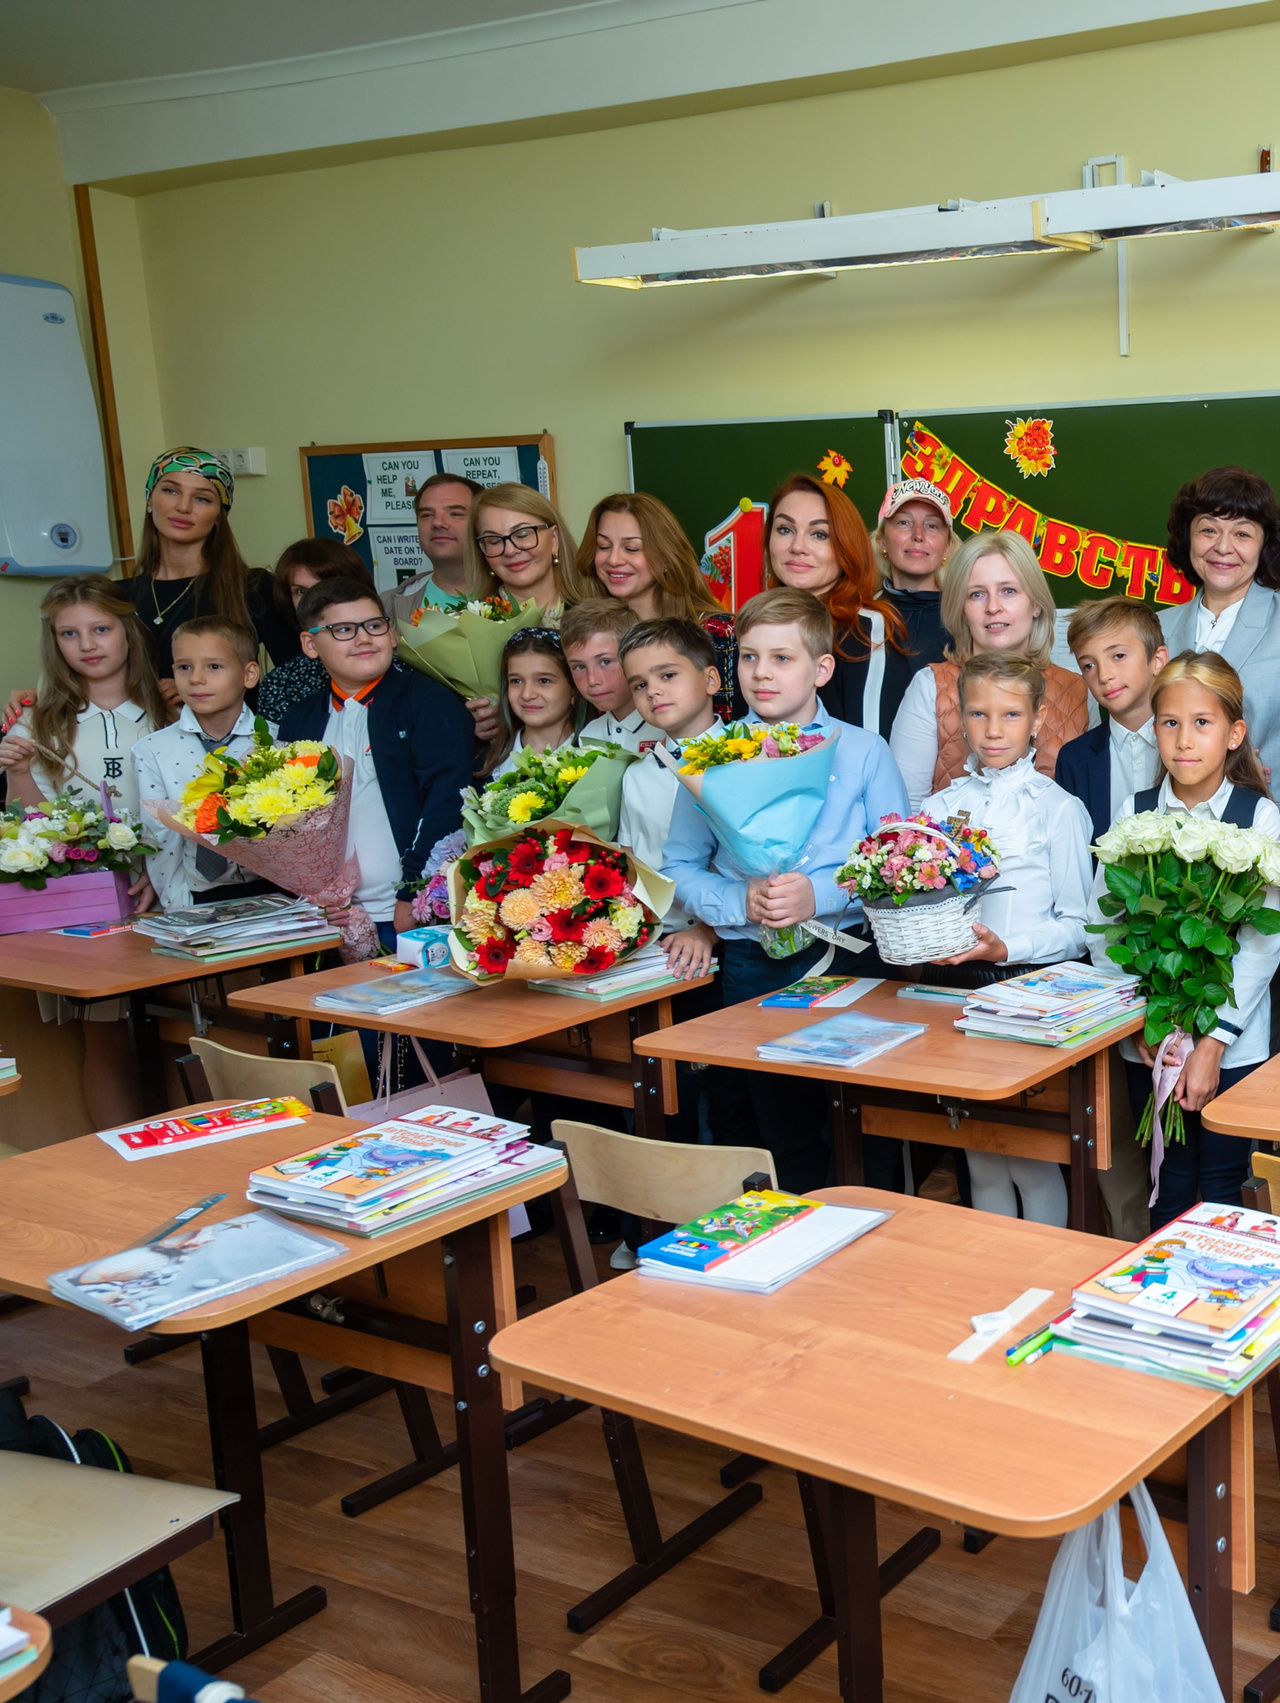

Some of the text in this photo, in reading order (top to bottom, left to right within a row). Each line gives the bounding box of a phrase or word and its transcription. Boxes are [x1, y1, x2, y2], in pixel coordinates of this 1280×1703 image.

[381, 460, 419, 471] CAN YOU
[463, 456, 501, 467] CAN YOU
[376, 475, 398, 485] HELP
[465, 469, 500, 480] REPEAT,
[381, 488, 396, 499] ME,
[385, 500, 416, 511] PLEAS
[901, 424, 1197, 606] ЗДРАВСТВ
[376, 535, 393, 544] CAN
[397, 535, 419, 544] WRITE
[384, 546, 403, 555] DATE
[404, 546, 415, 555] ON
[393, 557, 423, 567] BOARD?
[1161, 1290, 1179, 1300] 4
